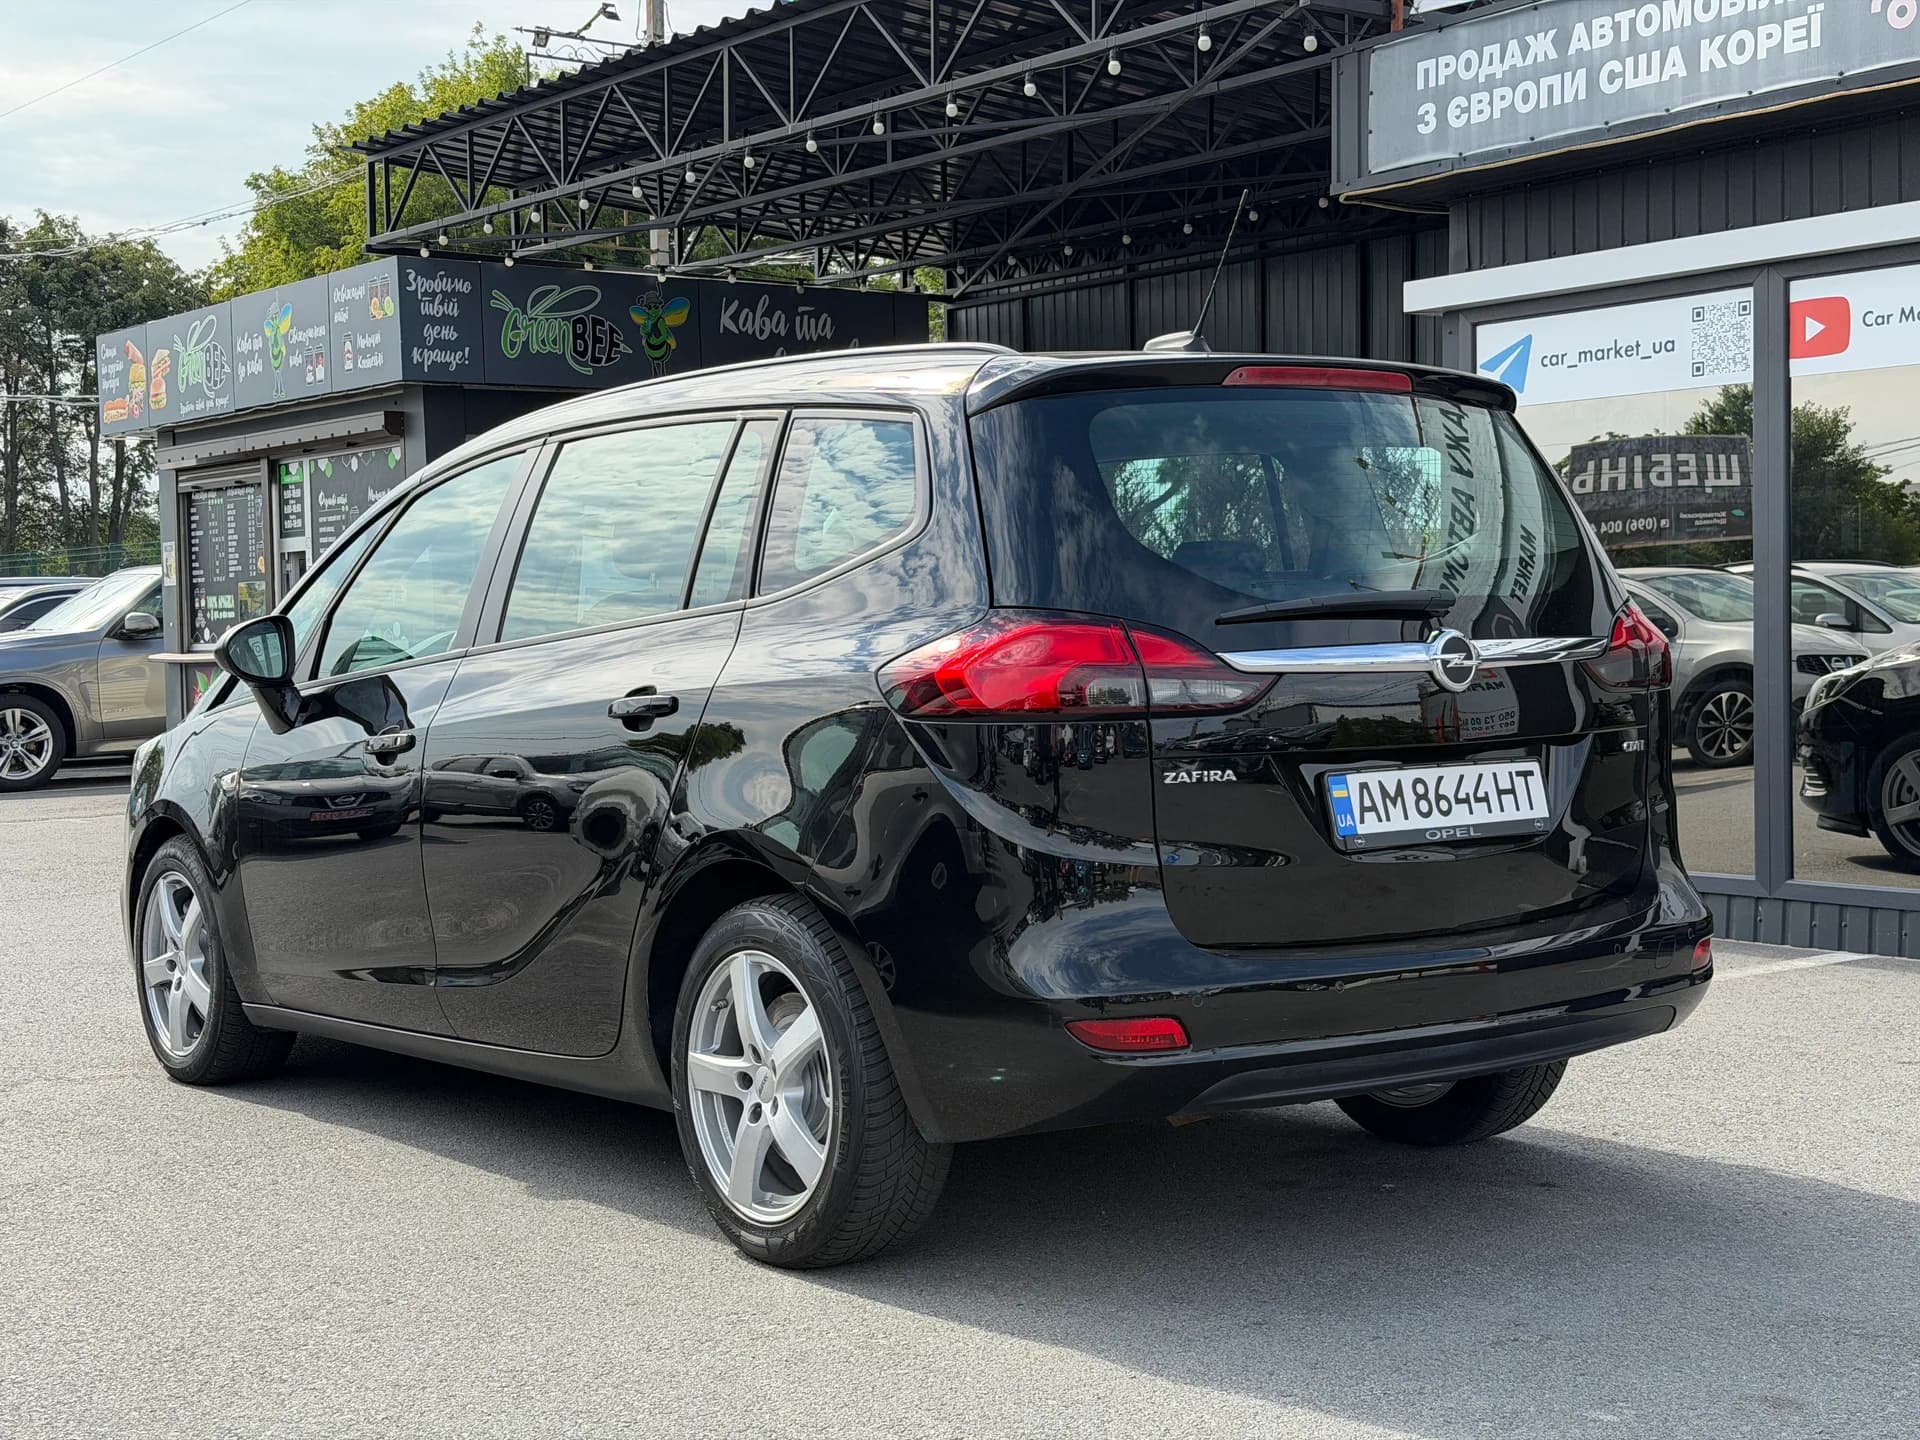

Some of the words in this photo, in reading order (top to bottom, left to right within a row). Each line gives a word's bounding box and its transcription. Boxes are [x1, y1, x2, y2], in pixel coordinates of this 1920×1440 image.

[1416, 28, 1558, 91] ПРОДАЖ
[1416, 102, 1437, 135] З
[1447, 68, 1587, 129] ЄВРОПИ
[1598, 45, 1688, 95] США
[1700, 3, 1825, 73] КОРЕЇ
[404, 268, 473, 299] Зробимо
[420, 293, 460, 318] твій
[719, 294, 790, 341] Кава
[795, 305, 836, 342] та
[1862, 310, 1894, 327] Car
[423, 323, 459, 346] день
[411, 346, 471, 373] краще!
[1540, 339, 1676, 369] car_market_ua
[1163, 769, 1238, 784] ZAFIRA
[1337, 814, 1355, 828] UA
[1425, 827, 1482, 840] OPEL
